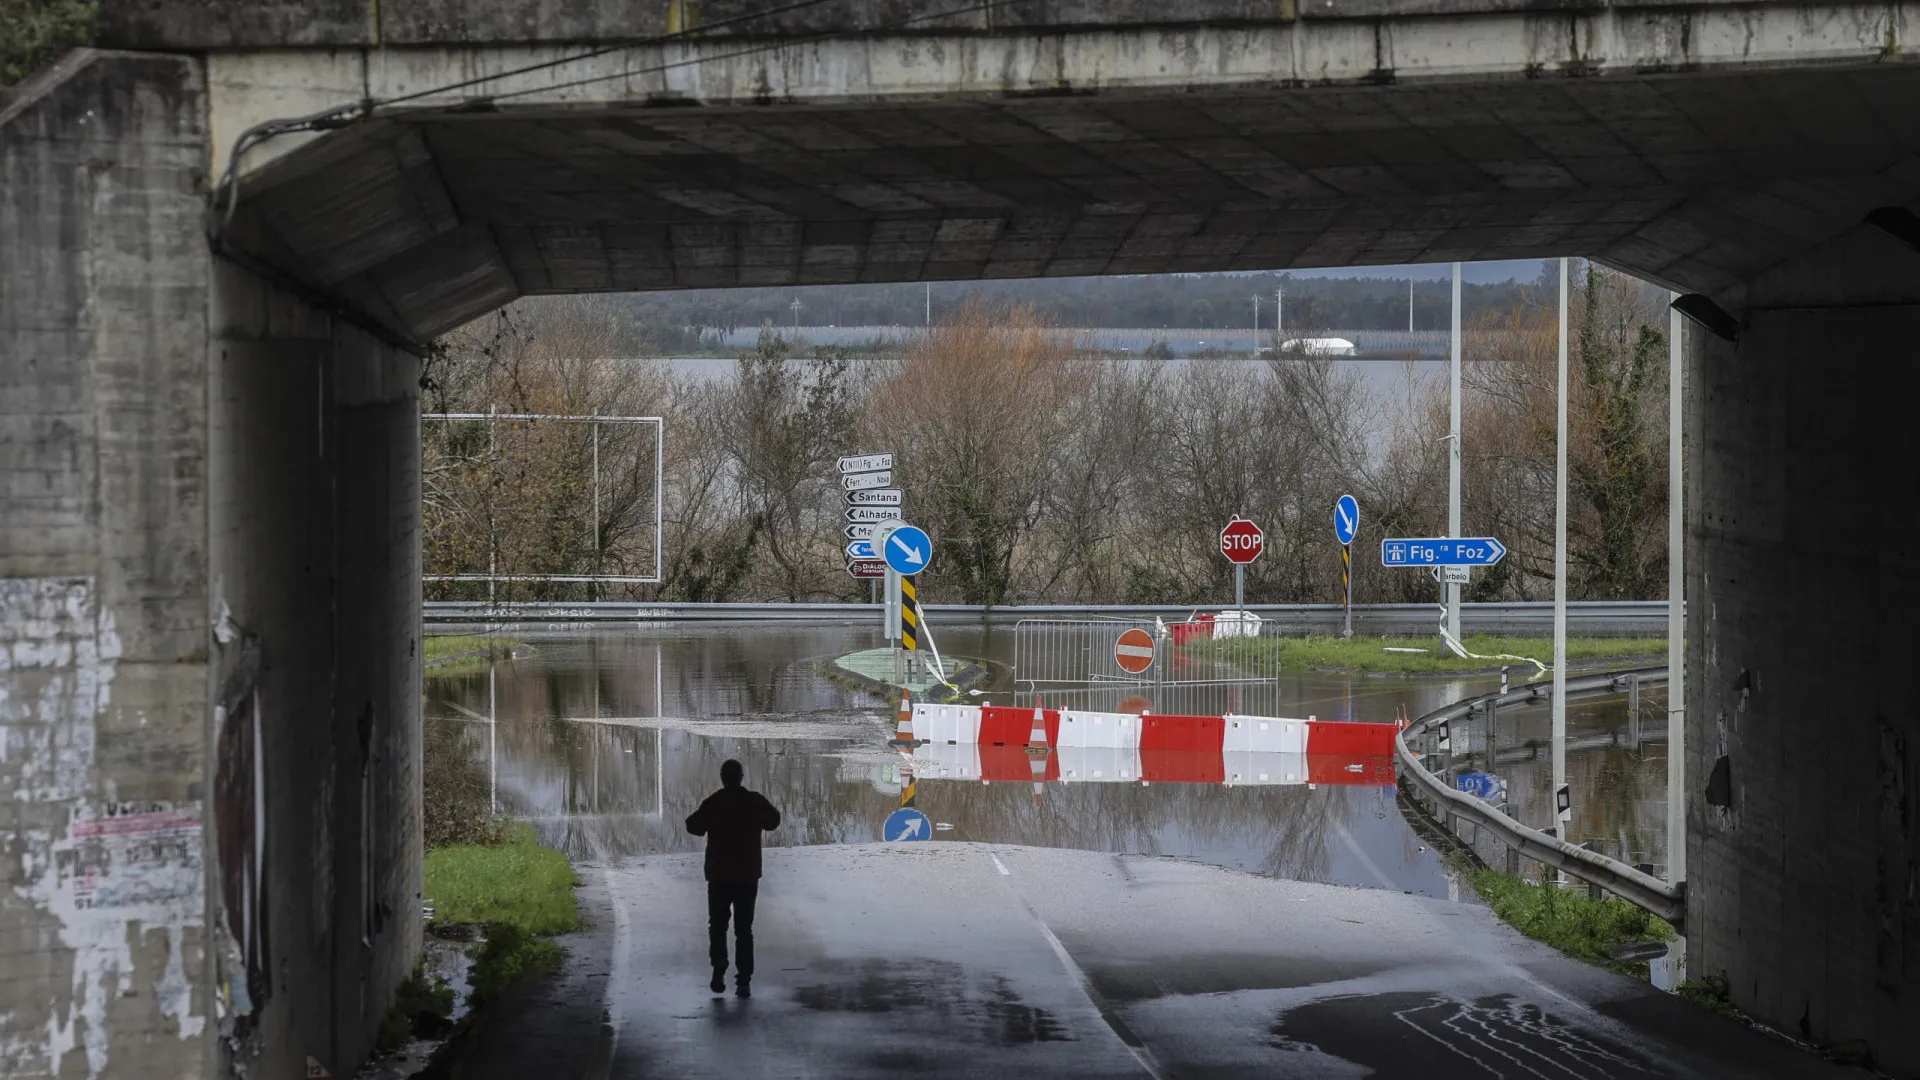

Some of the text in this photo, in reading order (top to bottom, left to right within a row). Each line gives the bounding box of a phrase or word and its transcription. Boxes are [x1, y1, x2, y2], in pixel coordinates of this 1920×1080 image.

[858, 492, 898, 502] Santana
[858, 510, 898, 519] Alhadas
[1222, 534, 1261, 550] STOP
[1456, 545, 1485, 559] Foz
